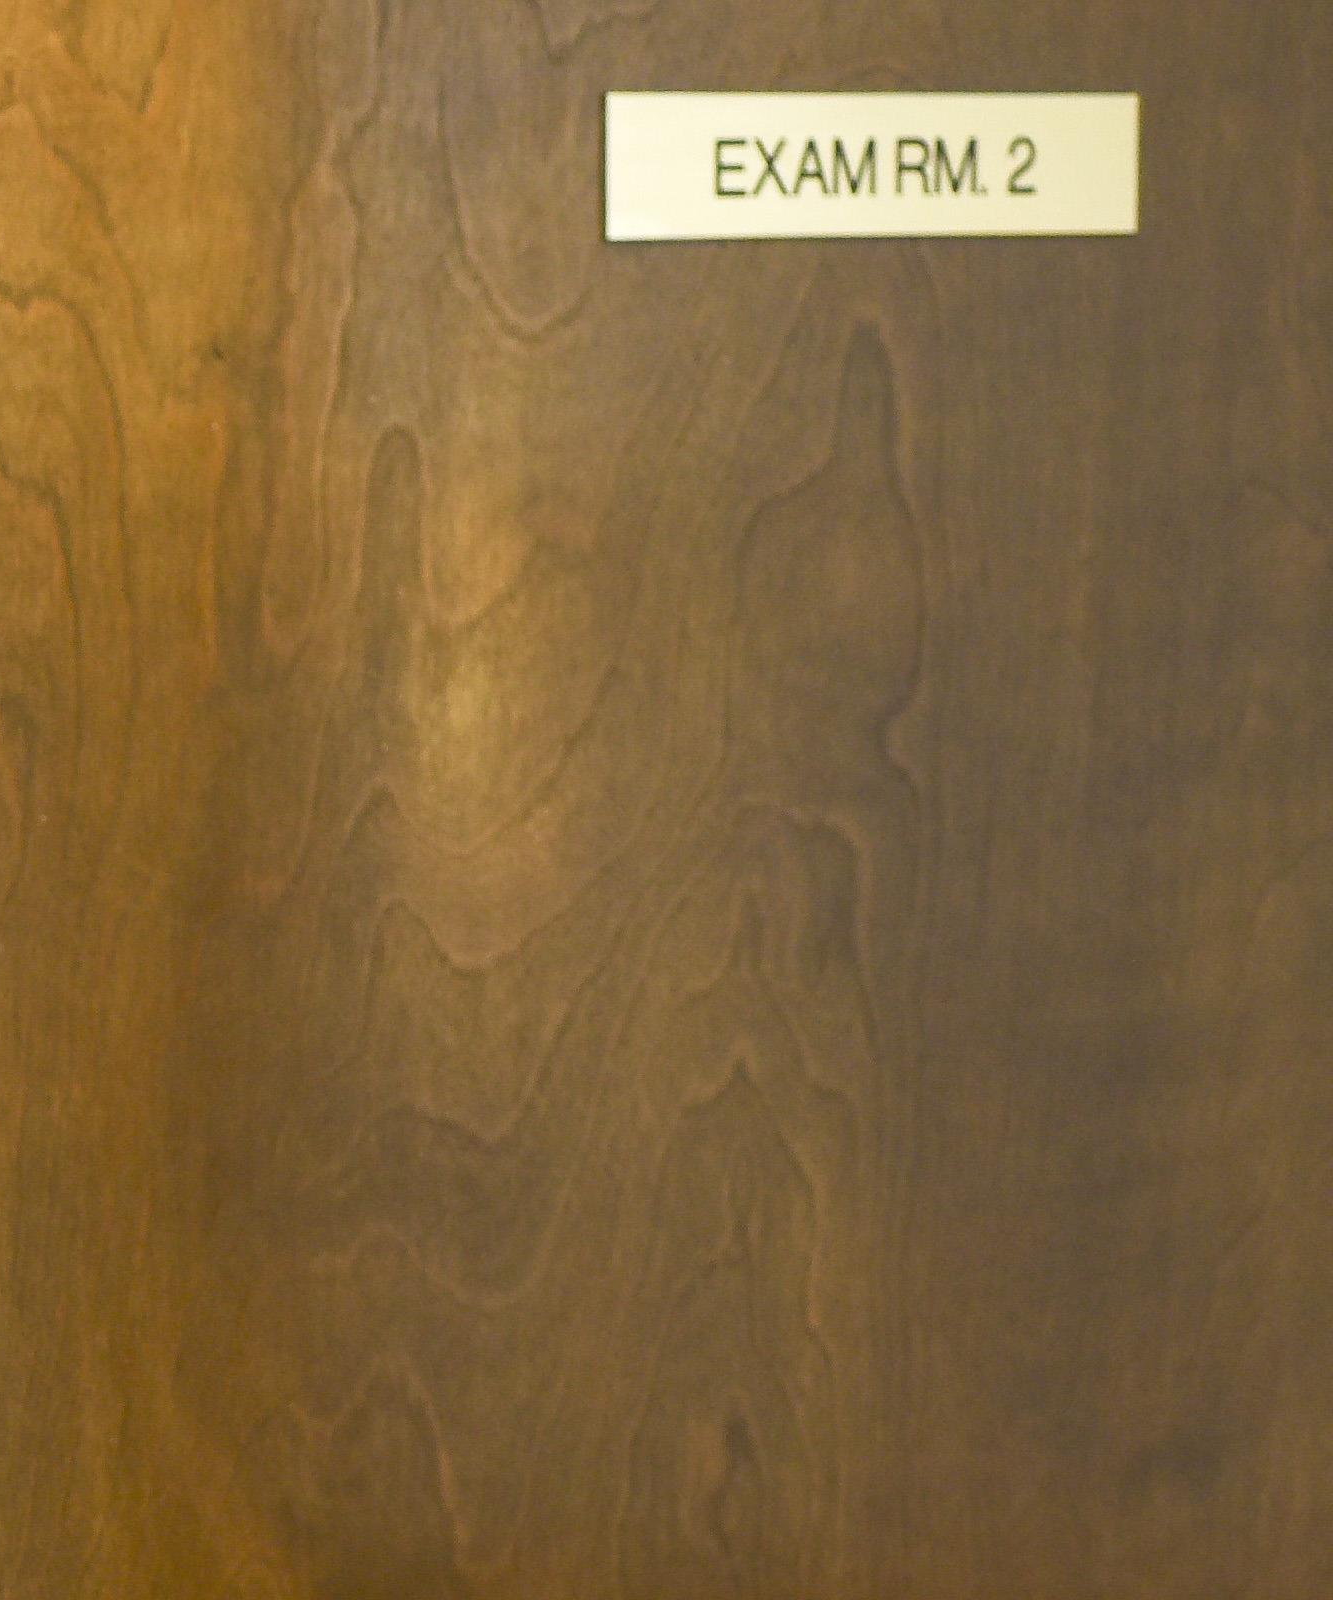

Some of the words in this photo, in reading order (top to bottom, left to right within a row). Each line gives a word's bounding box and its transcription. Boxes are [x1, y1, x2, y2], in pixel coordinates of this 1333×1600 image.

[714, 136, 876, 197] EXAM
[896, 136, 988, 196] RM.
[1008, 135, 1038, 195] 2
